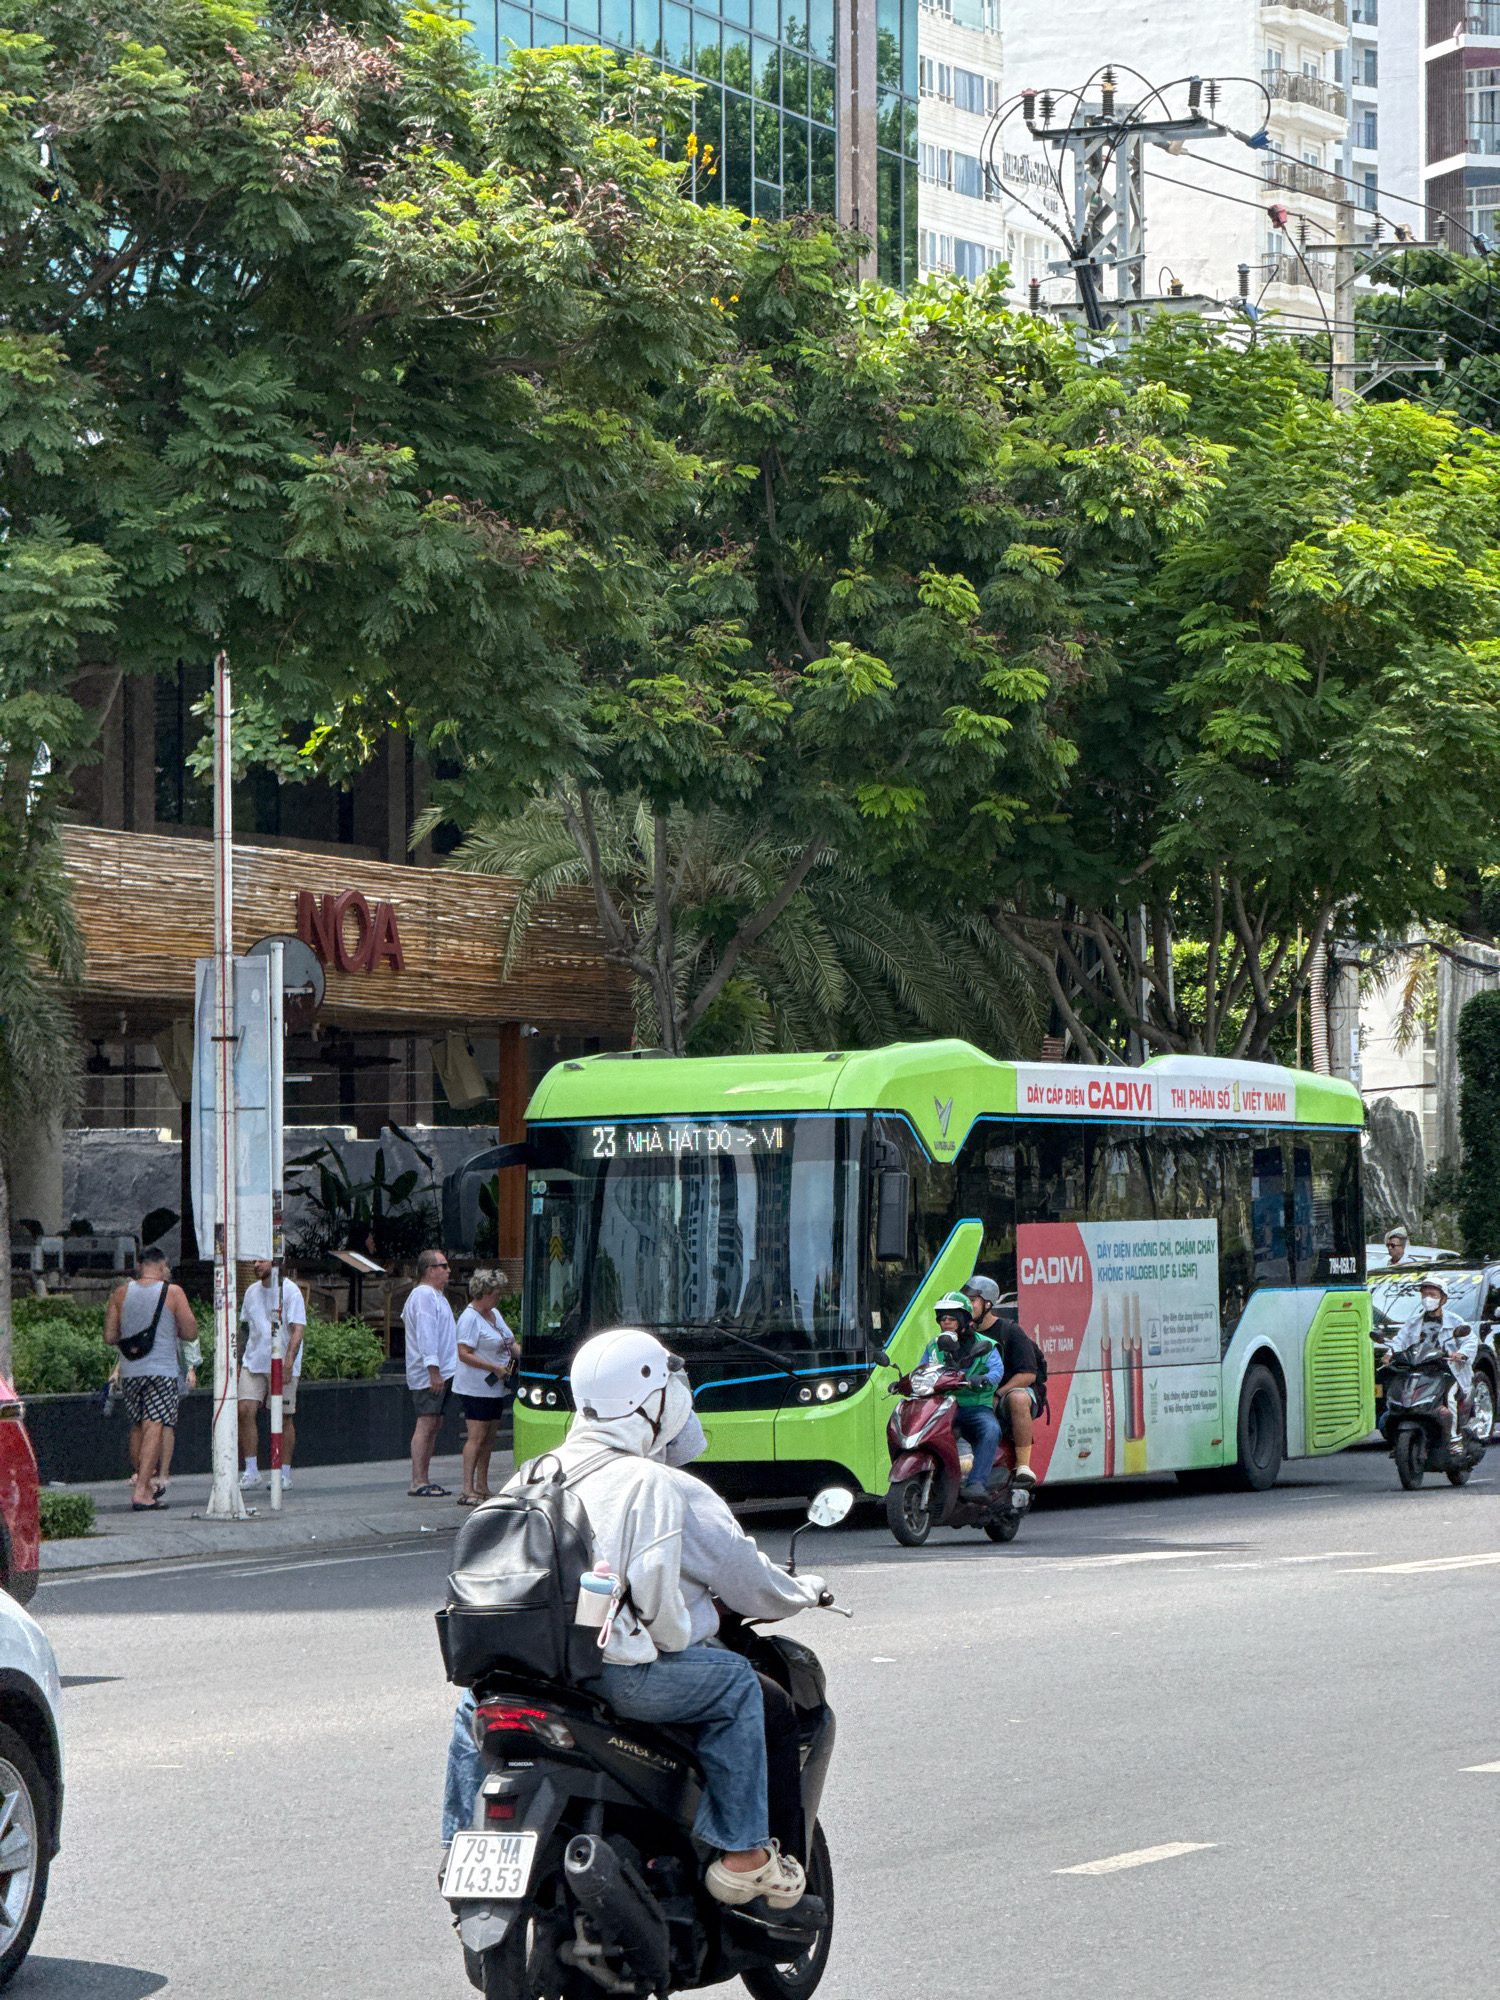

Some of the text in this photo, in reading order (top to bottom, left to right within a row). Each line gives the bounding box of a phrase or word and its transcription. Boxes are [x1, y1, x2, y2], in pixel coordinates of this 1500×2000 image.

[296, 889, 406, 972] NOA
[1027, 1081, 1152, 1111] DÂY CÁP ĐIỆN CADIVI
[1170, 1080, 1286, 1114] THỊ PHẦN SỐ 1 VIỆT NAM
[592, 1127, 616, 1157] 23
[628, 1126, 663, 1152] NHÀ
[669, 1124, 701, 1151] HÁT
[707, 1123, 732, 1149] ĐÓ
[1096, 1240, 1112, 1259] DÂY
[1114, 1240, 1131, 1261] ĐIỆN
[1132, 1239, 1158, 1257] KHÔNG
[1175, 1238, 1196, 1257] CHẬM
[1020, 1256, 1083, 1285] CADIVI
[1098, 1263, 1123, 1282] KHÔNG
[1125, 1264, 1158, 1281] HALOGEN
[462, 1838, 522, 1865] 79-HA
[455, 1866, 522, 1893] 143.53
